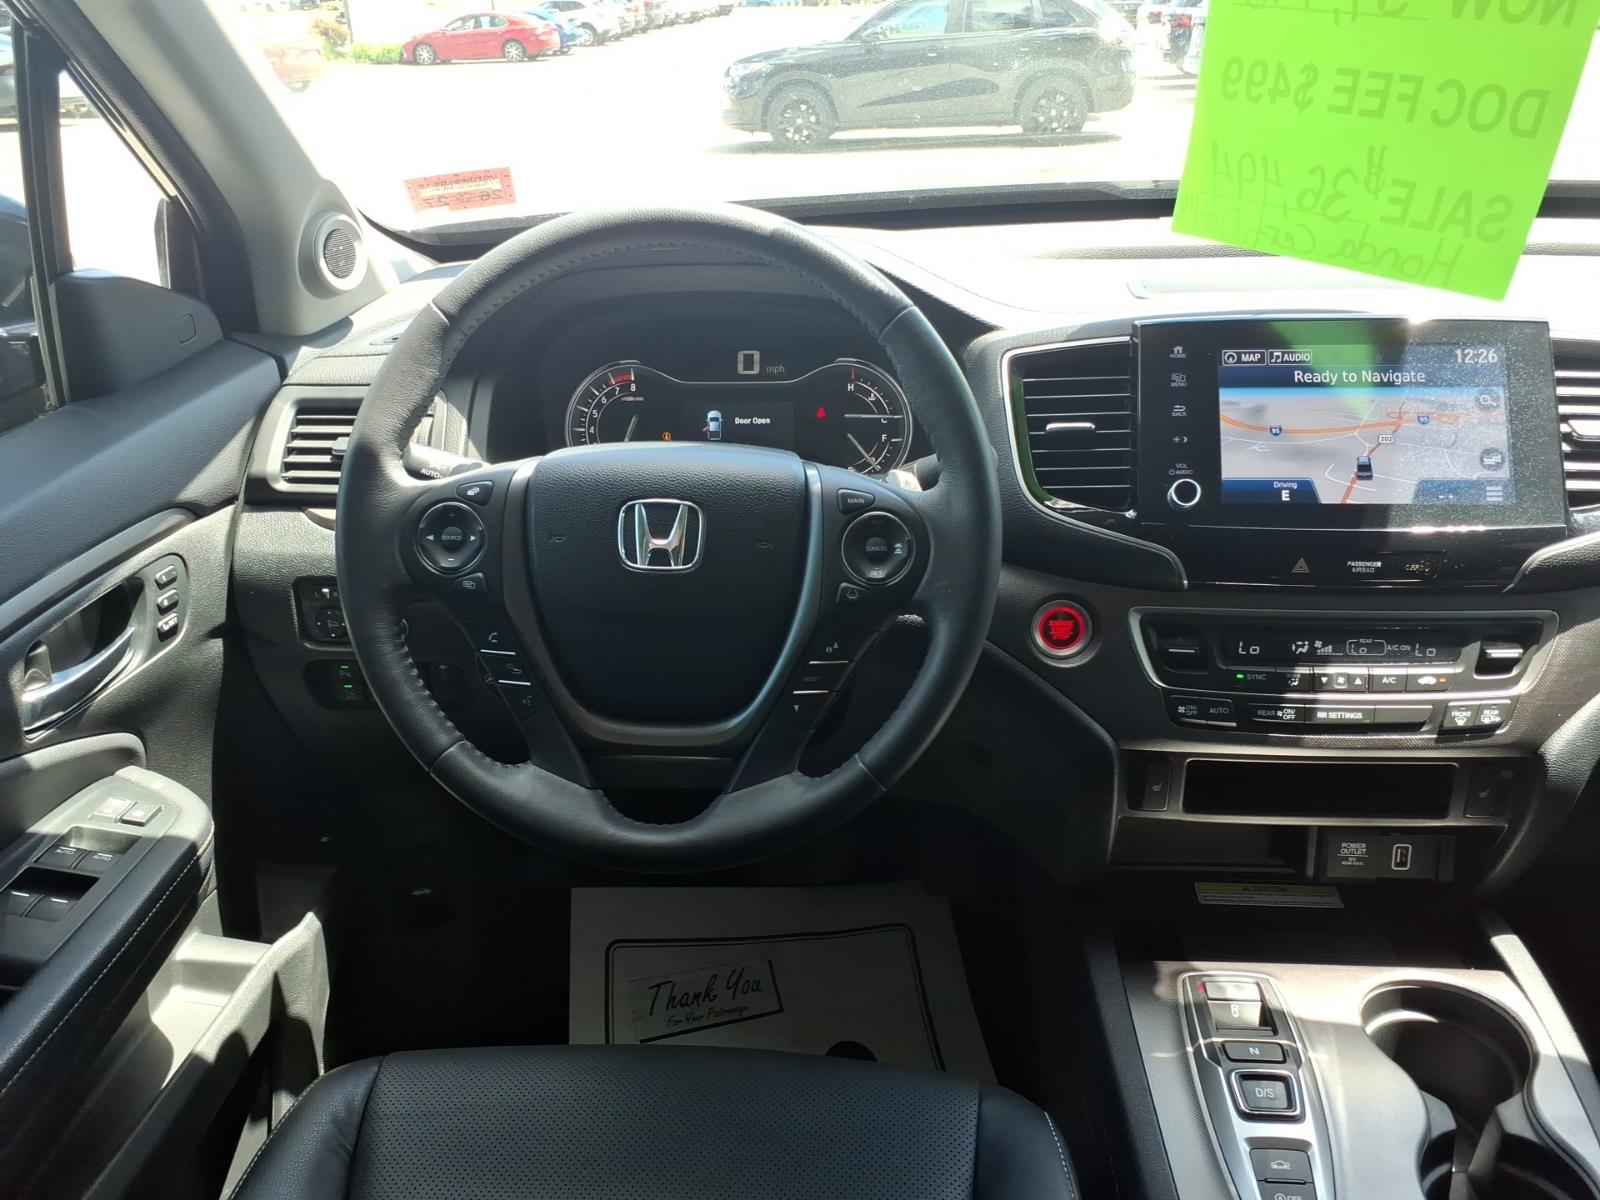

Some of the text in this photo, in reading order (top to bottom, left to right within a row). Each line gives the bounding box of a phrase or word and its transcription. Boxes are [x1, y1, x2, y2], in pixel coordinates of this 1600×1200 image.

[1241, 353, 1261, 362] MAP
[1283, 353, 1311, 362] AUDIO
[1455, 348, 1499, 364] 12:26
[766, 364, 785, 375] mph
[1294, 370, 1426, 386] Ready to Navigate
[614, 387, 621, 396] 7
[629, 383, 636, 393] 8
[847, 383, 854, 392] H
[601, 396, 607, 405] 6
[592, 409, 599, 418] 5
[734, 417, 771, 426] Door Open
[589, 425, 595, 434] 4
[881, 434, 888, 443] F
[1273, 480, 1298, 490] Driving
[1282, 490, 1290, 501] E
[1386, 643, 1399, 651] A/C
[1381, 676, 1397, 684] A/C
[1257, 709, 1276, 717] REAR
[1317, 711, 1363, 720] RR SETTINGS
[648, 966, 762, 1016] Thank You
[1249, 1047, 1260, 1055] N
[1255, 1087, 1275, 1099] D/S
